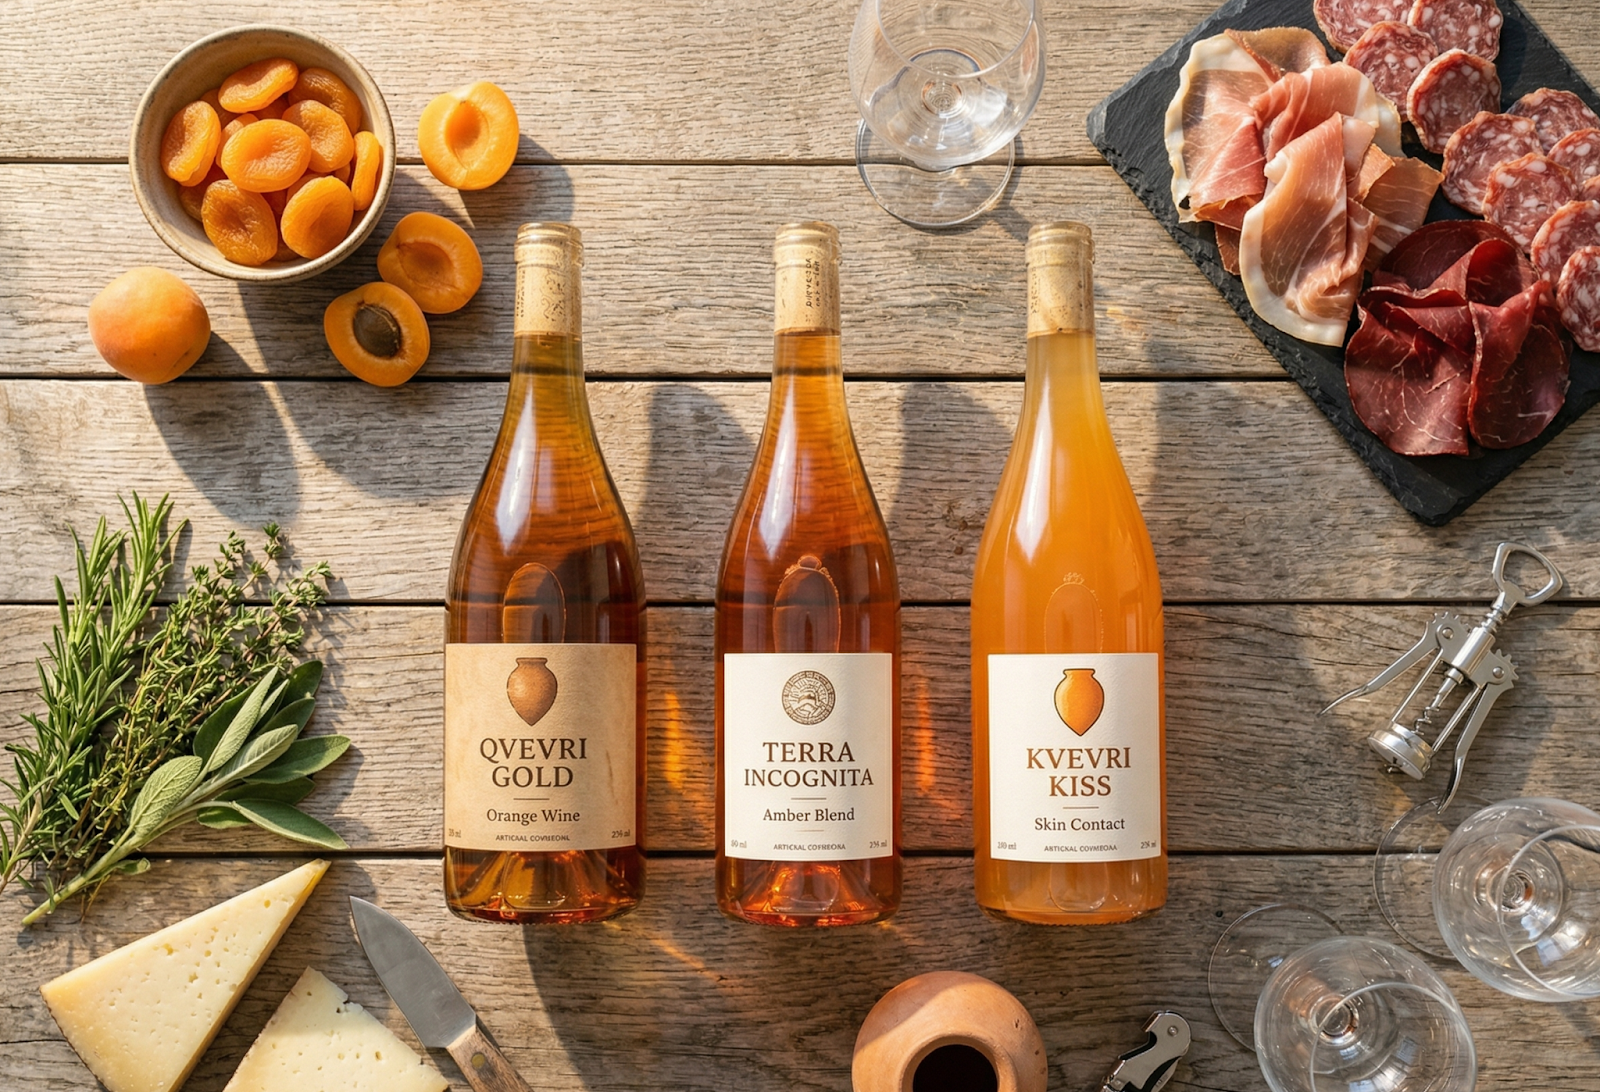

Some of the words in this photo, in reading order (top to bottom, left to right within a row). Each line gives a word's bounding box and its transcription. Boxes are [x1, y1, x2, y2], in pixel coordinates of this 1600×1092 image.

[480, 737, 588, 764] QVEVRI
[763, 741, 855, 763] TERRA
[1027, 747, 1131, 770] KVEVRI
[492, 766, 574, 788] GOLD
[744, 768, 874, 787] INCOGNITA
[1049, 775, 1112, 796] KISS
[487, 808, 538, 826] Orange
[541, 808, 580, 822] Wine
[763, 808, 811, 822] Amber
[815, 807, 855, 821] Blend
[1035, 817, 1067, 831] Skin
[1071, 817, 1125, 831] Contact
